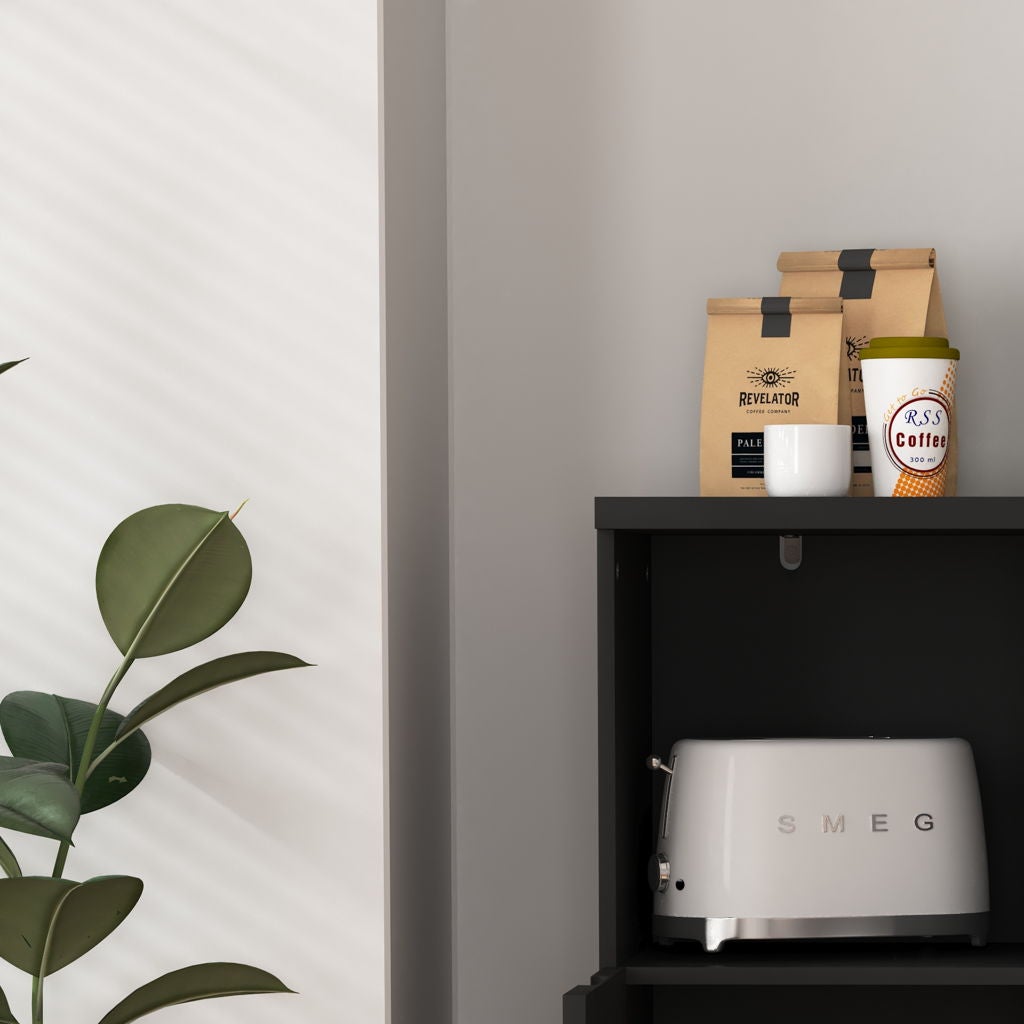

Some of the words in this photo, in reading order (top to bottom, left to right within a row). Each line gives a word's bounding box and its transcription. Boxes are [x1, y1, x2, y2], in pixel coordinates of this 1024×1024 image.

[739, 392, 800, 407] REVELATOR
[737, 438, 763, 448] PALE
[896, 432, 946, 448] Coffee
[777, 813, 934, 834] SMEG
